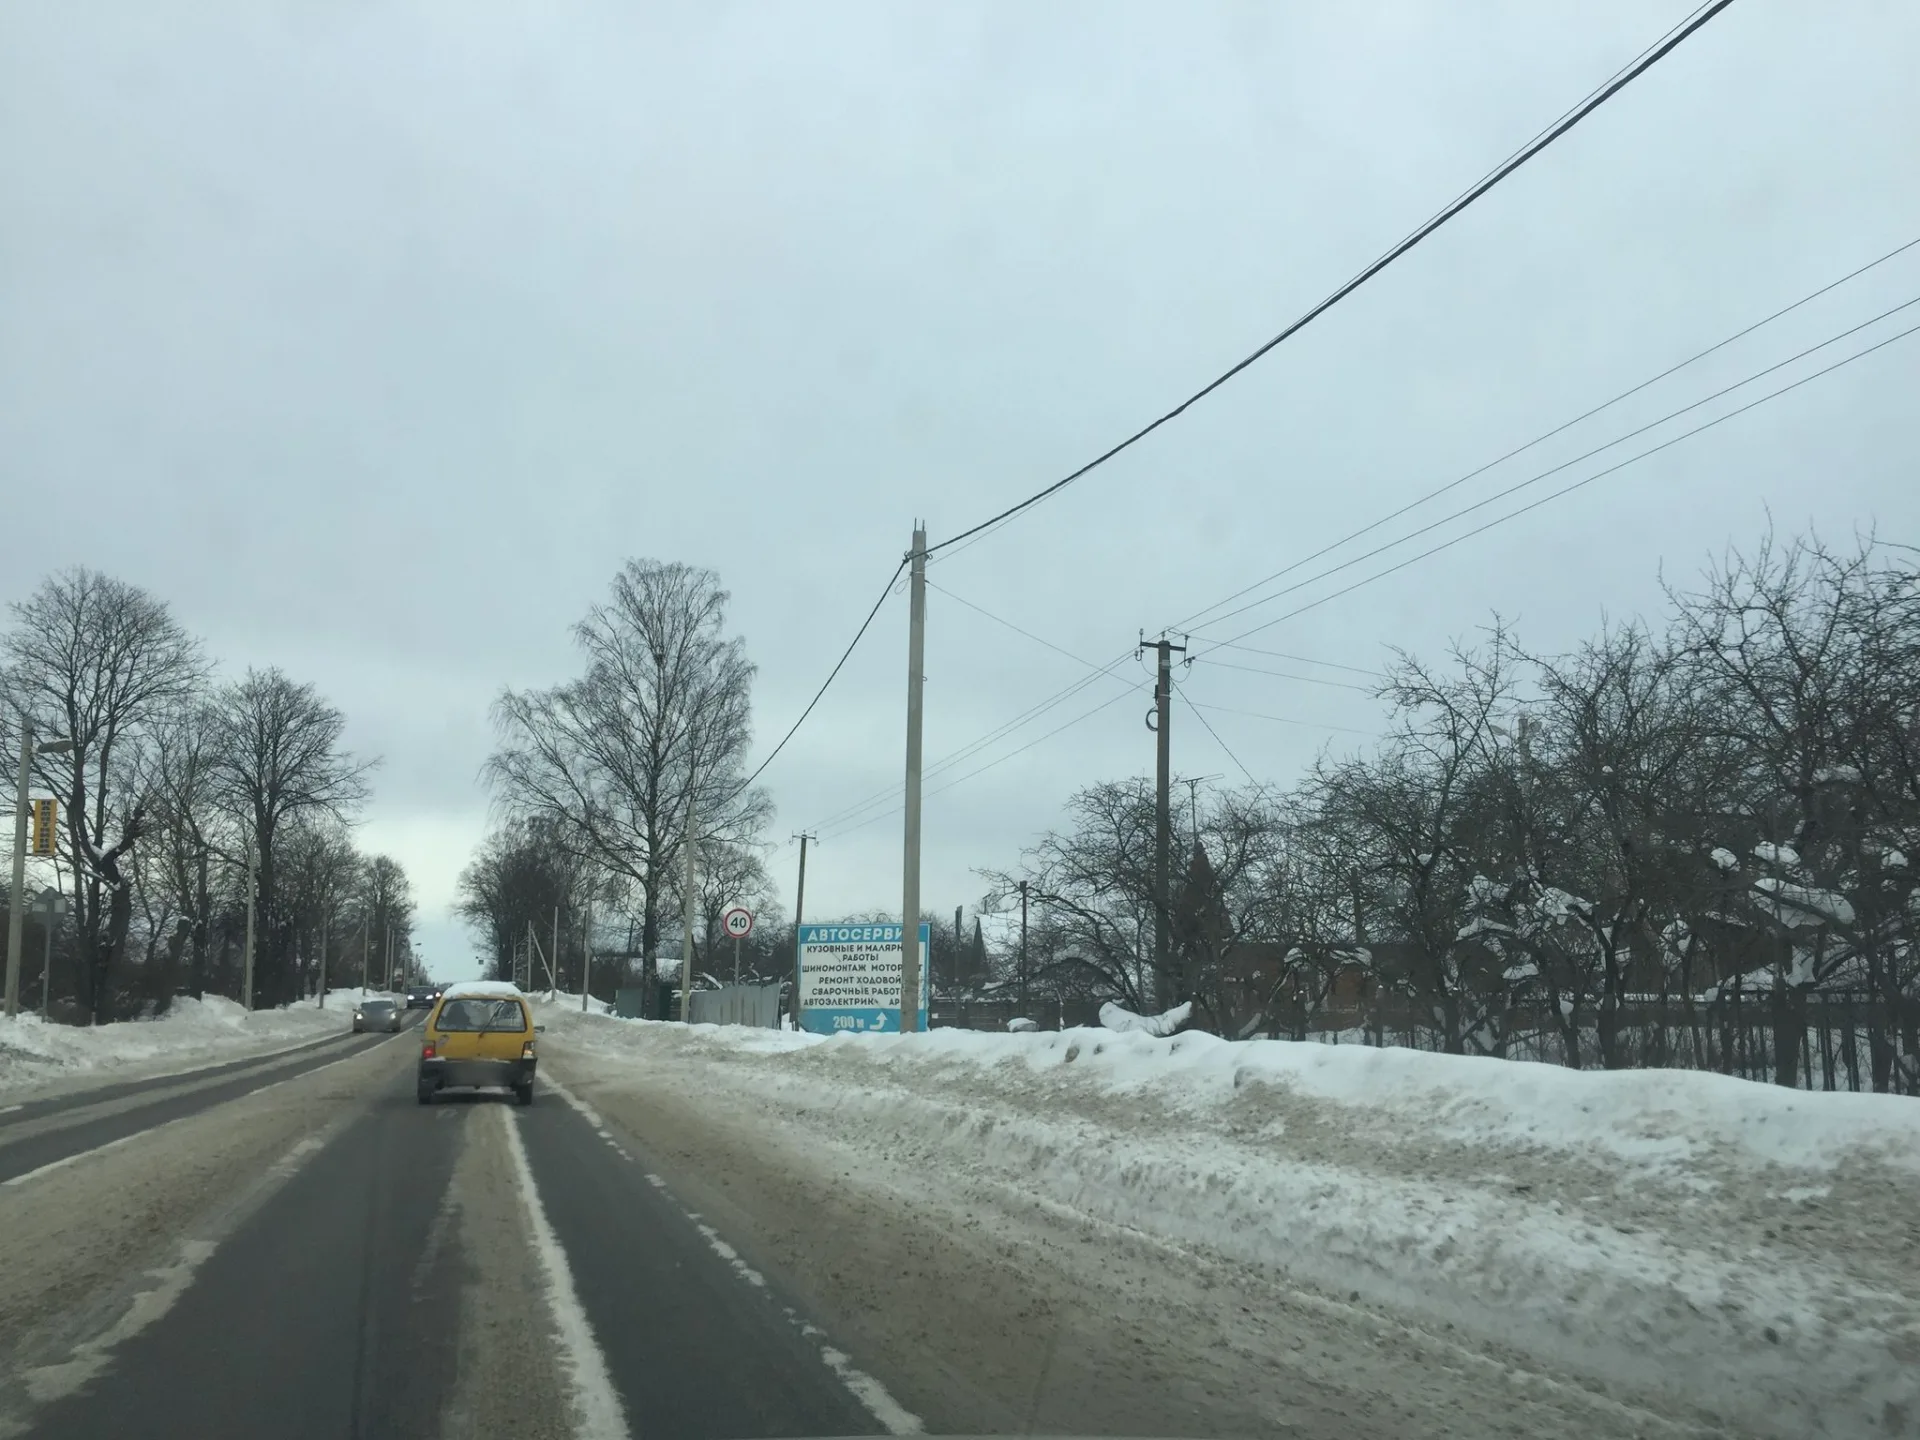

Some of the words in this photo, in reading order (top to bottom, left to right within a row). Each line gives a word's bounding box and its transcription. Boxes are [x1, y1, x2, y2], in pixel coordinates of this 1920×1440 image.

[730, 917, 747, 928] 40
[807, 928, 903, 941] АВТОСЕРВИ
[807, 945, 854, 953] КУЗОВНЫЕ
[856, 944, 863, 952] И
[865, 944, 903, 952] МАЛЯРН
[842, 953, 879, 961] РАБОТЫ
[802, 964, 867, 973] ШИНОМОНТАЖ
[818, 976, 854, 984] РЕМОНТ
[857, 974, 901, 984] ХОДОВОЙ
[812, 987, 869, 996] СВАРОЧНЫЕ
[871, 987, 900, 995] РАБОТ
[833, 1016, 854, 1029] 200
